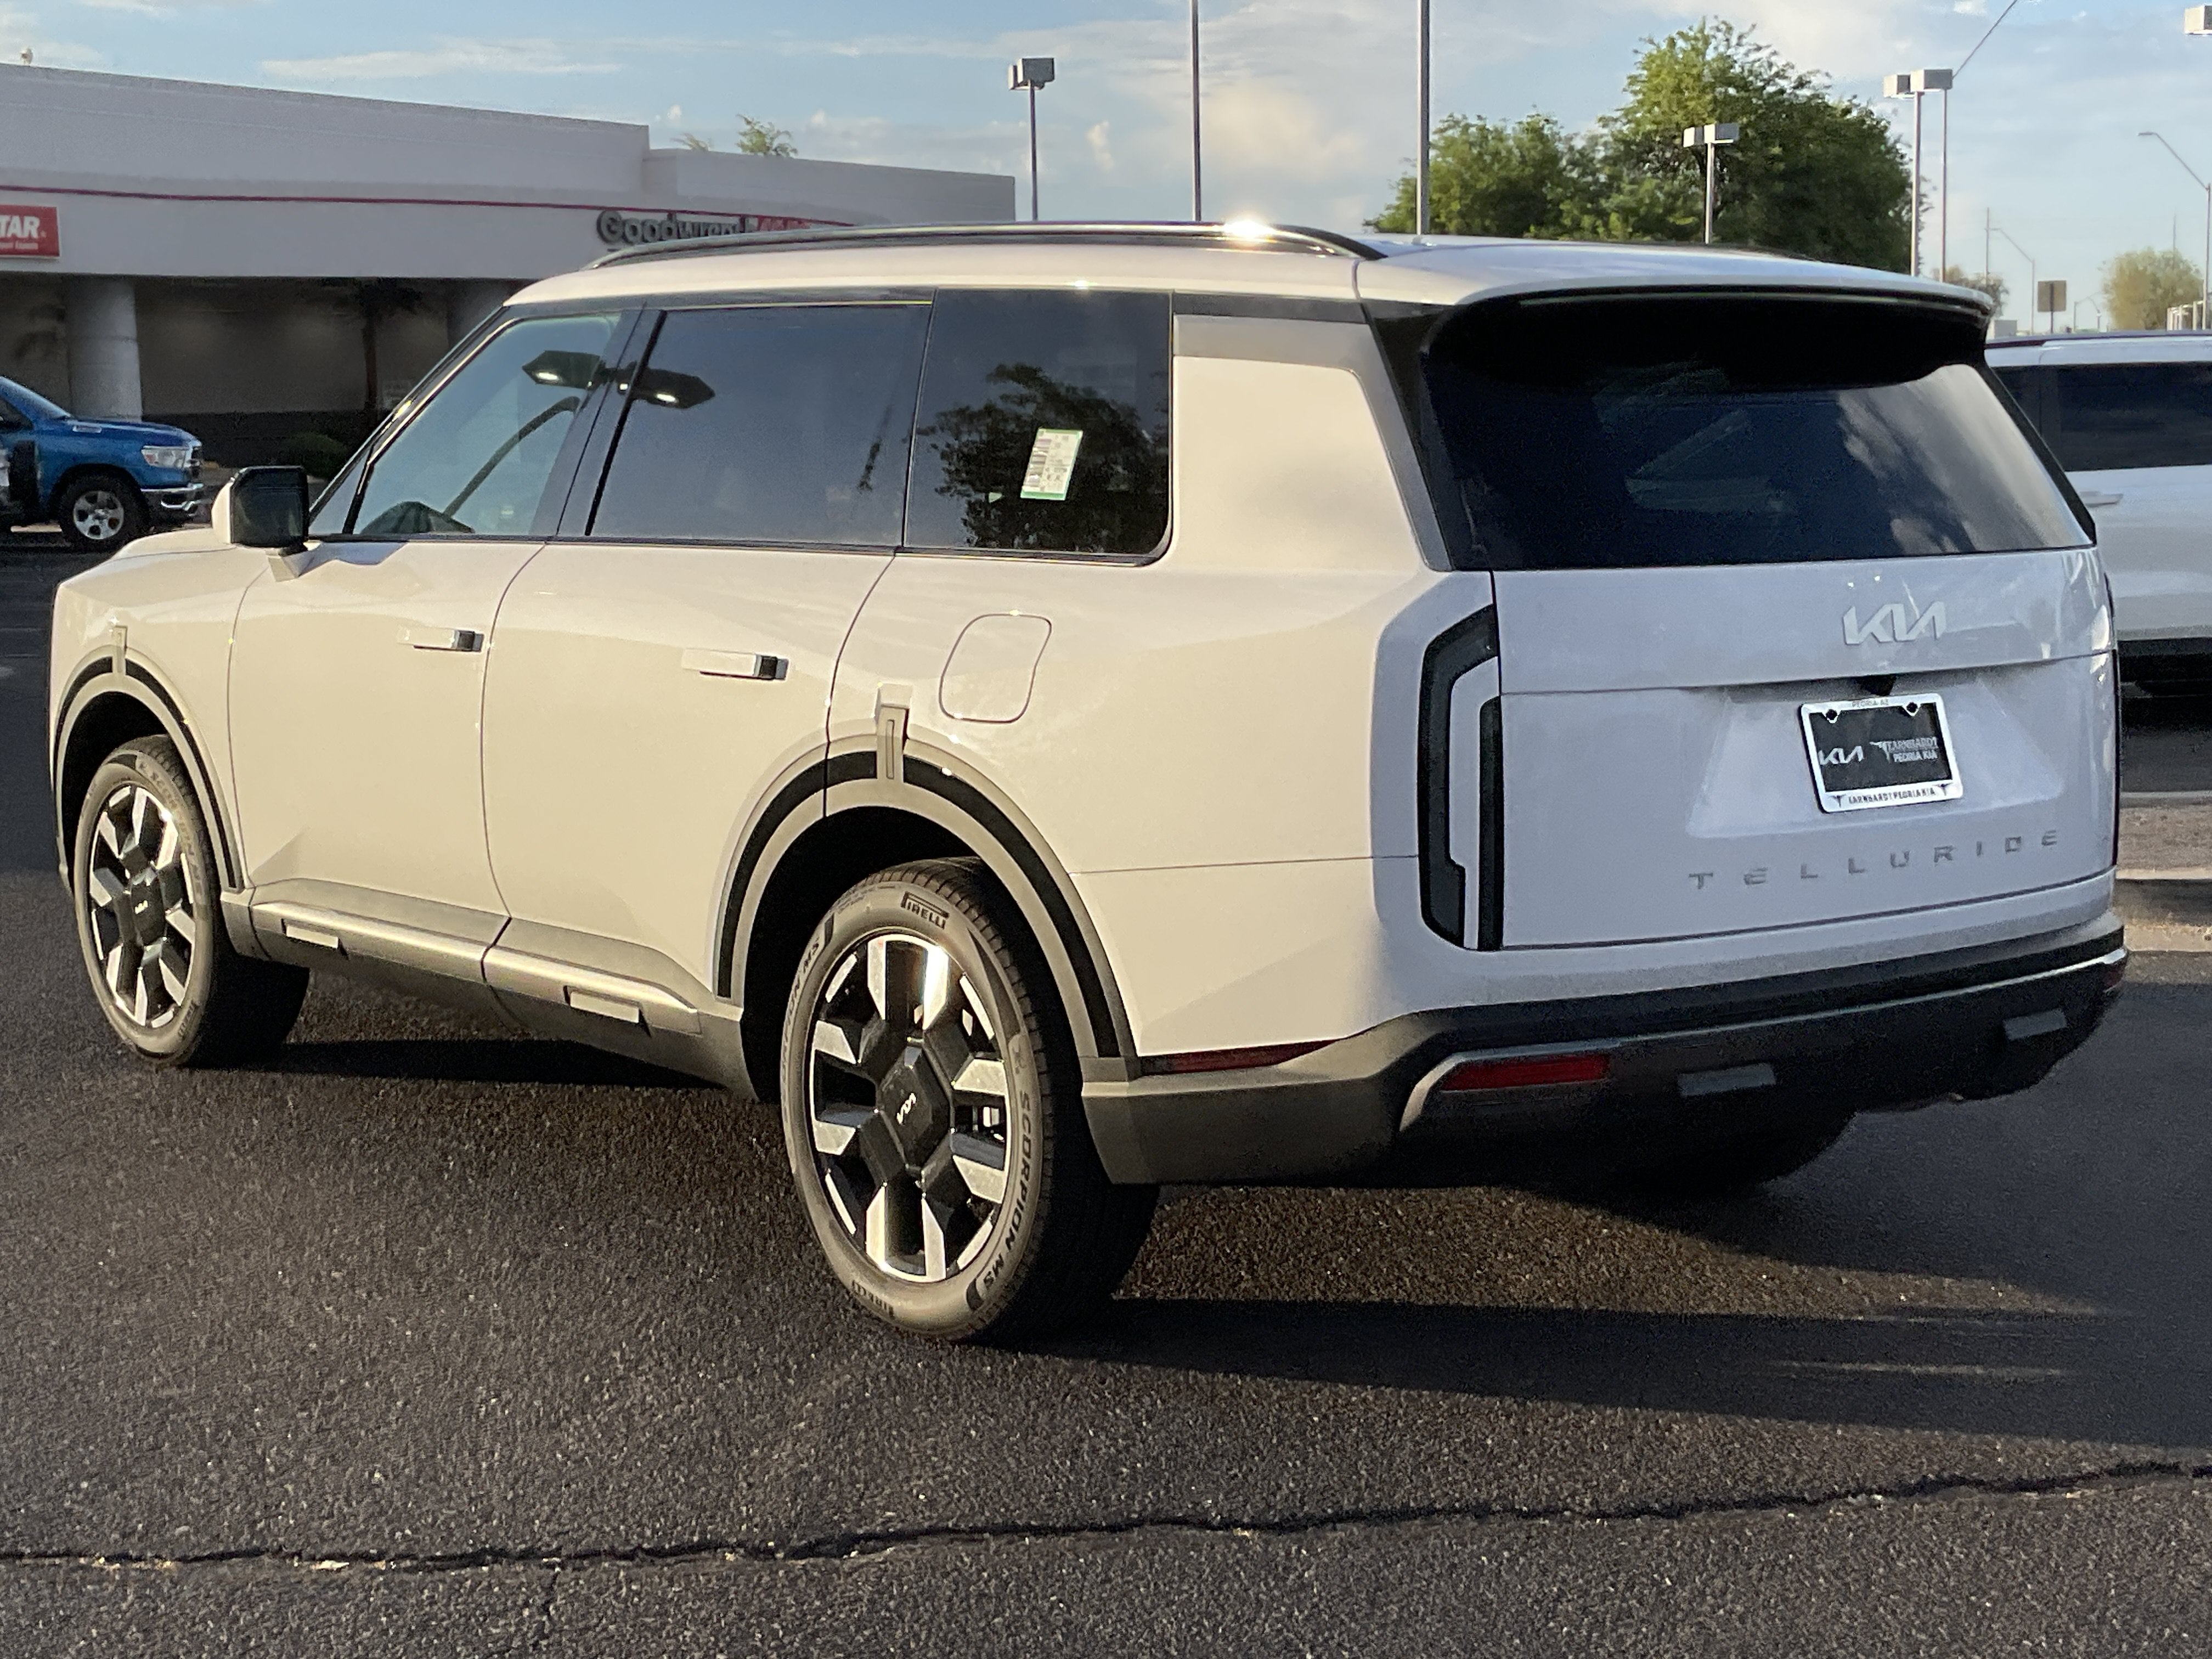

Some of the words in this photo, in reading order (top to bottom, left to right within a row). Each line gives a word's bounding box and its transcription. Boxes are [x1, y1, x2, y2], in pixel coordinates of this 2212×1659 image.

[1842, 601, 1947, 646] KIA
[1818, 745, 1865, 766] KIA
[1689, 830, 2058, 890] TELLURIDE
[901, 891, 950, 930] PIRELLI
[1005, 1089, 1033, 1251] SCORPION
